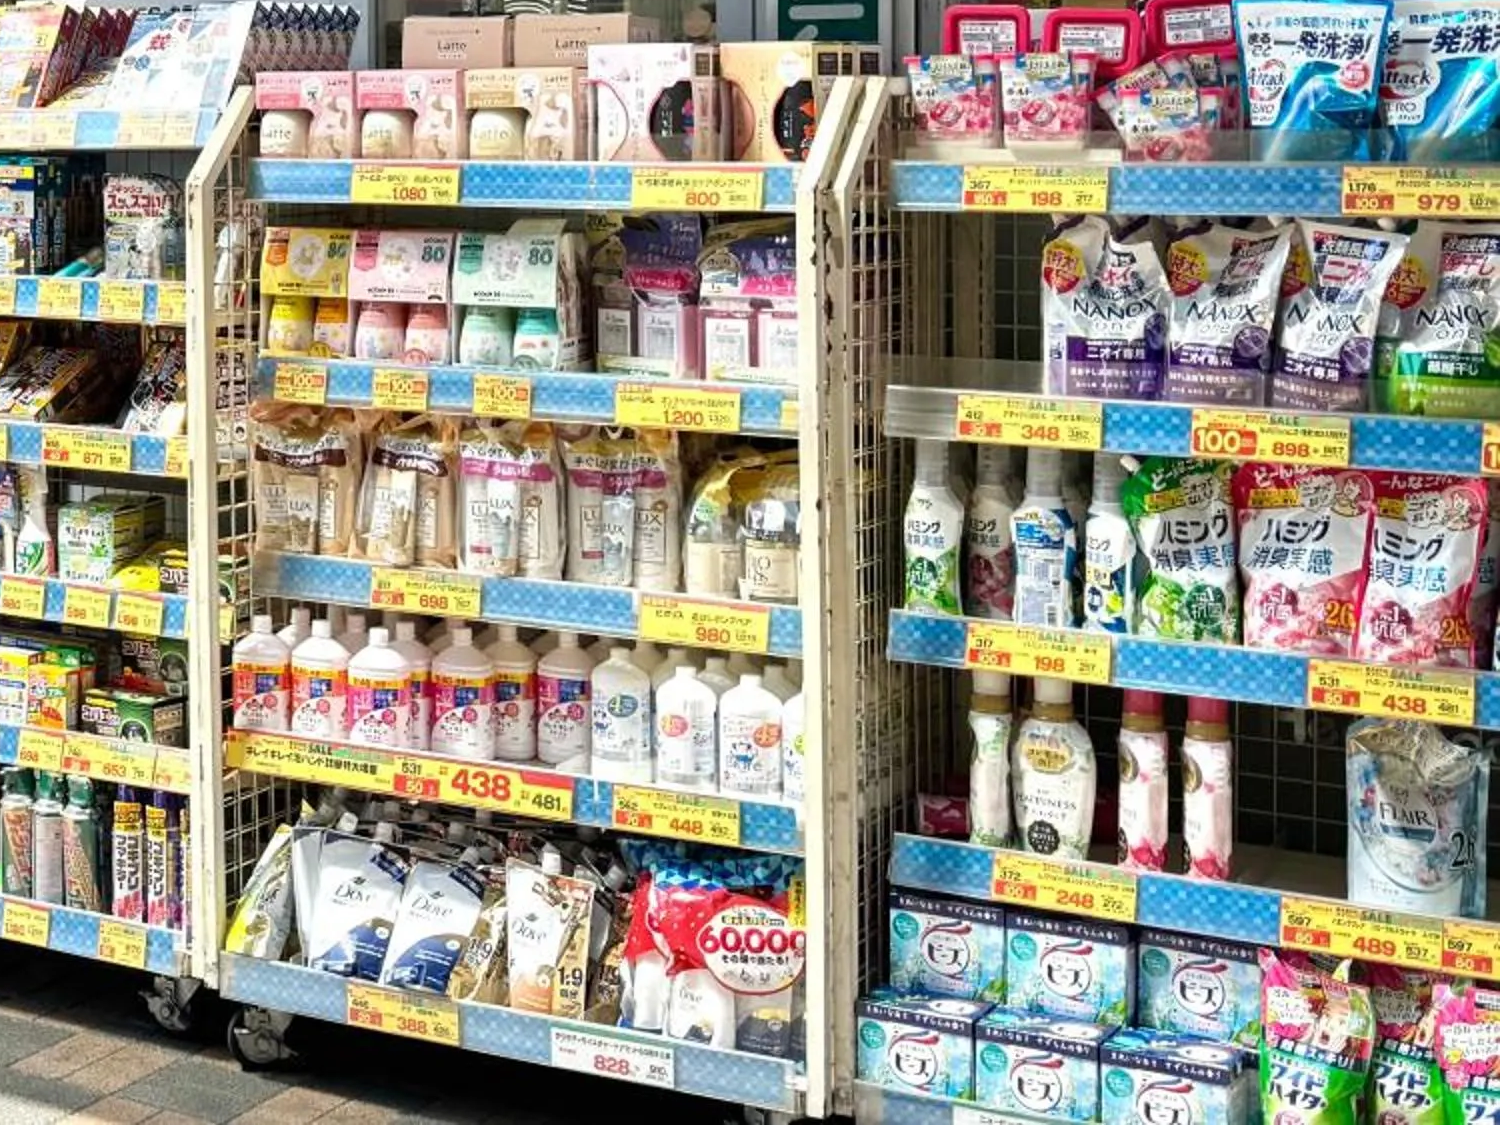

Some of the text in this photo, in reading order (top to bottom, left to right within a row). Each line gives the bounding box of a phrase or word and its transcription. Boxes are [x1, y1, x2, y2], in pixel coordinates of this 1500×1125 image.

[437, 41, 467, 52] Latte
[555, 38, 587, 50] Latte
[684, 192, 720, 206] 800
[1030, 190, 1062, 206] 198
[1418, 194, 1460, 210] 979
[1073, 298, 1157, 320] NANOX
[1188, 301, 1259, 323] NANOX
[1416, 305, 1489, 329] NANOX
[1021, 423, 1060, 441] 348
[1196, 429, 1242, 453] 100
[1272, 440, 1309, 457] 898
[1160, 509, 1229, 544] ハミング
[1263, 515, 1331, 544] ハミング
[1249, 546, 1334, 575] 消臭実感
[420, 594, 448, 609] 698
[695, 626, 730, 643] 980
[1034, 656, 1065, 672] 198
[1382, 694, 1426, 714] 438
[451, 769, 510, 802] 438
[531, 793, 561, 811] 481
[1380, 802, 1433, 826] FLAIR
[669, 817, 703, 835] 448
[335, 884, 371, 903] Dove
[1056, 889, 1094, 909] 248
[412, 898, 452, 917] Dove
[1353, 936, 1396, 956] 489
[397, 1017, 427, 1034] 388
[593, 1055, 630, 1075] 828
